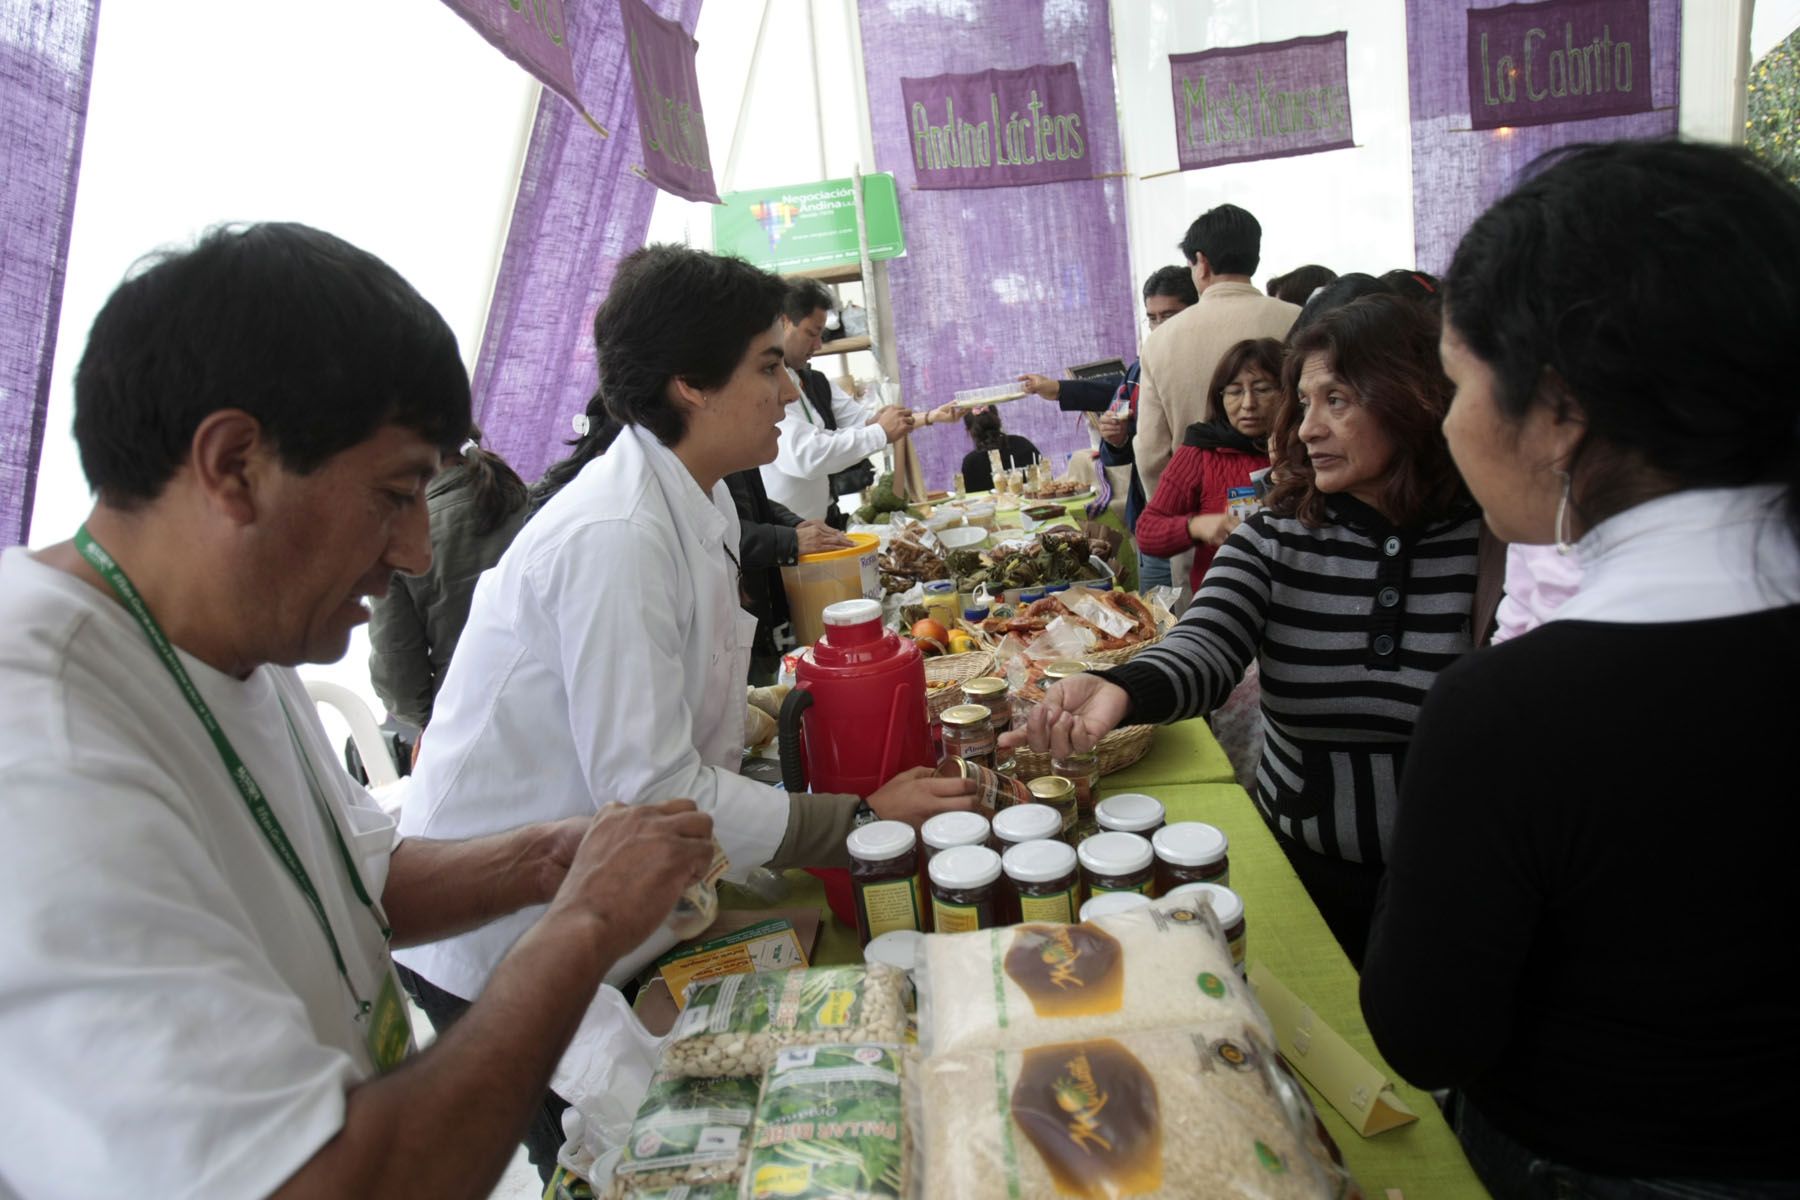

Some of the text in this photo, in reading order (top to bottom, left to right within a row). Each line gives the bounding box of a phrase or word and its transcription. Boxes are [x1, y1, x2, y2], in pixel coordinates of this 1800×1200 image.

[1480, 31, 1517, 106] La
[911, 89, 1085, 171] Andina Lácteos
[782, 186, 857, 205] Negociación
[800, 200, 842, 214] Andina
[817, 1120, 897, 1140] PALLAR
